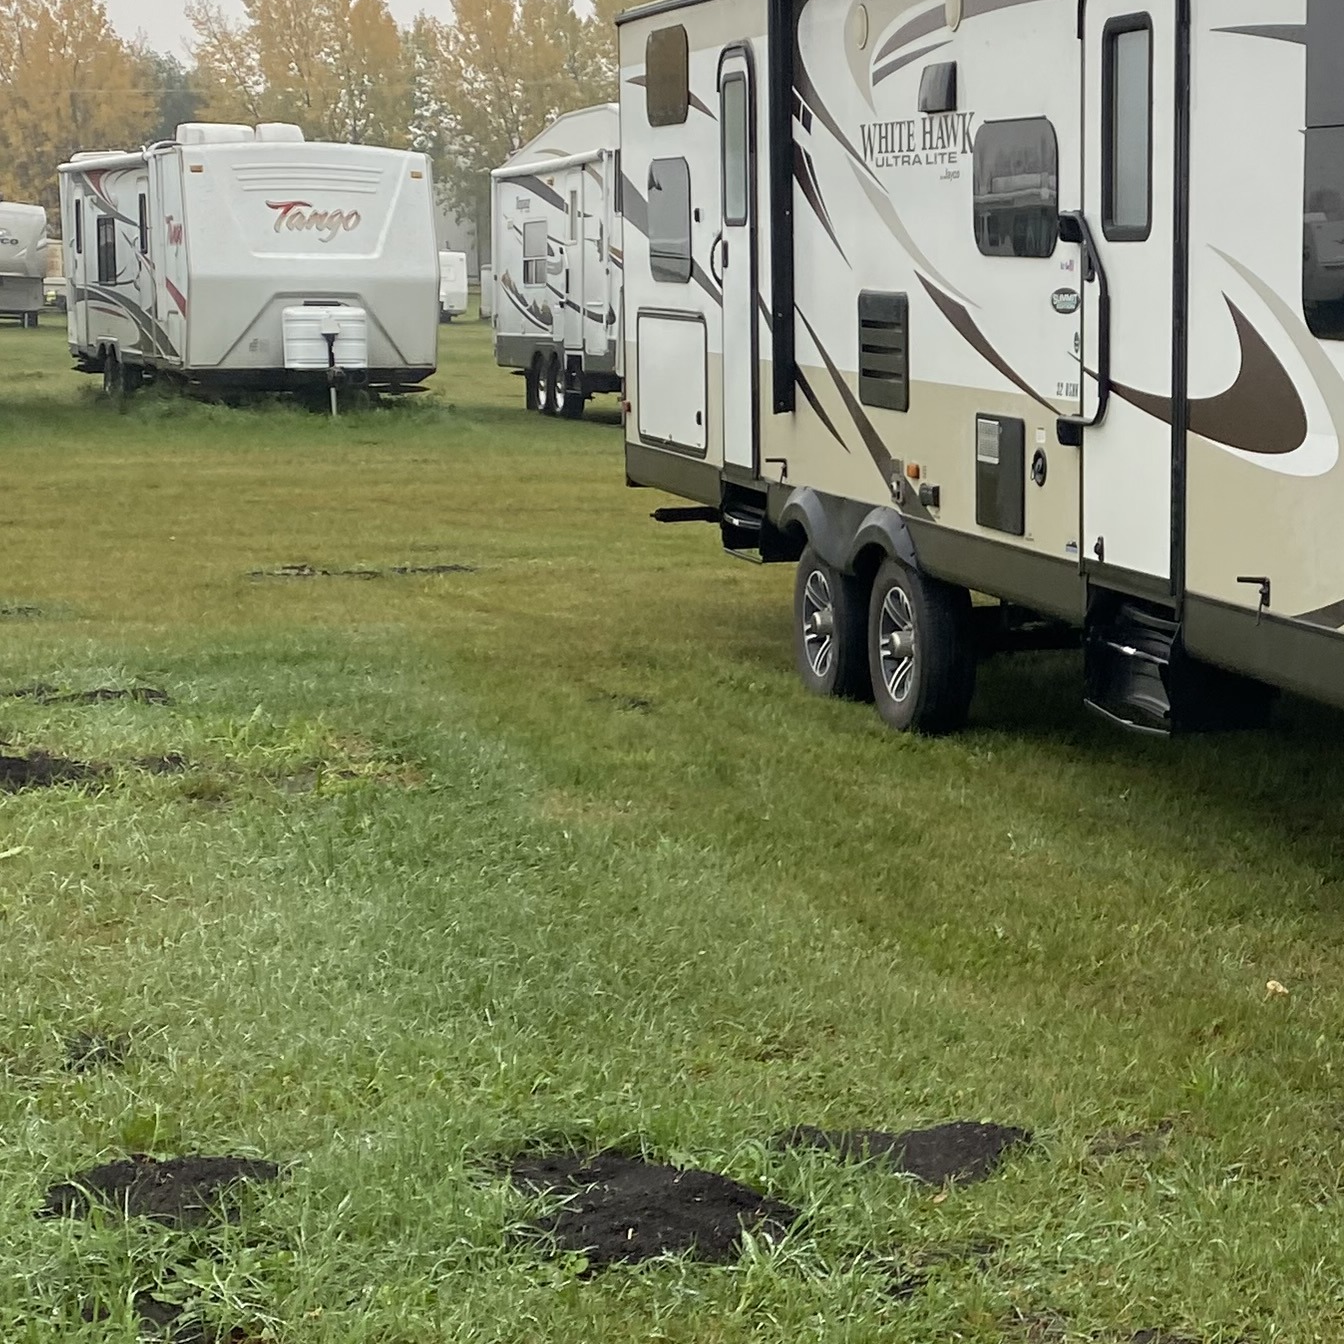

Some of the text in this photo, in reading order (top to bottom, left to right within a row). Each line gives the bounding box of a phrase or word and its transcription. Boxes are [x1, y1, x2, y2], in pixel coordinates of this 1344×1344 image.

[860, 111, 976, 162] WHITE HAWK
[875, 151, 958, 168] ULTRA LITE
[265, 200, 362, 243] Tango
